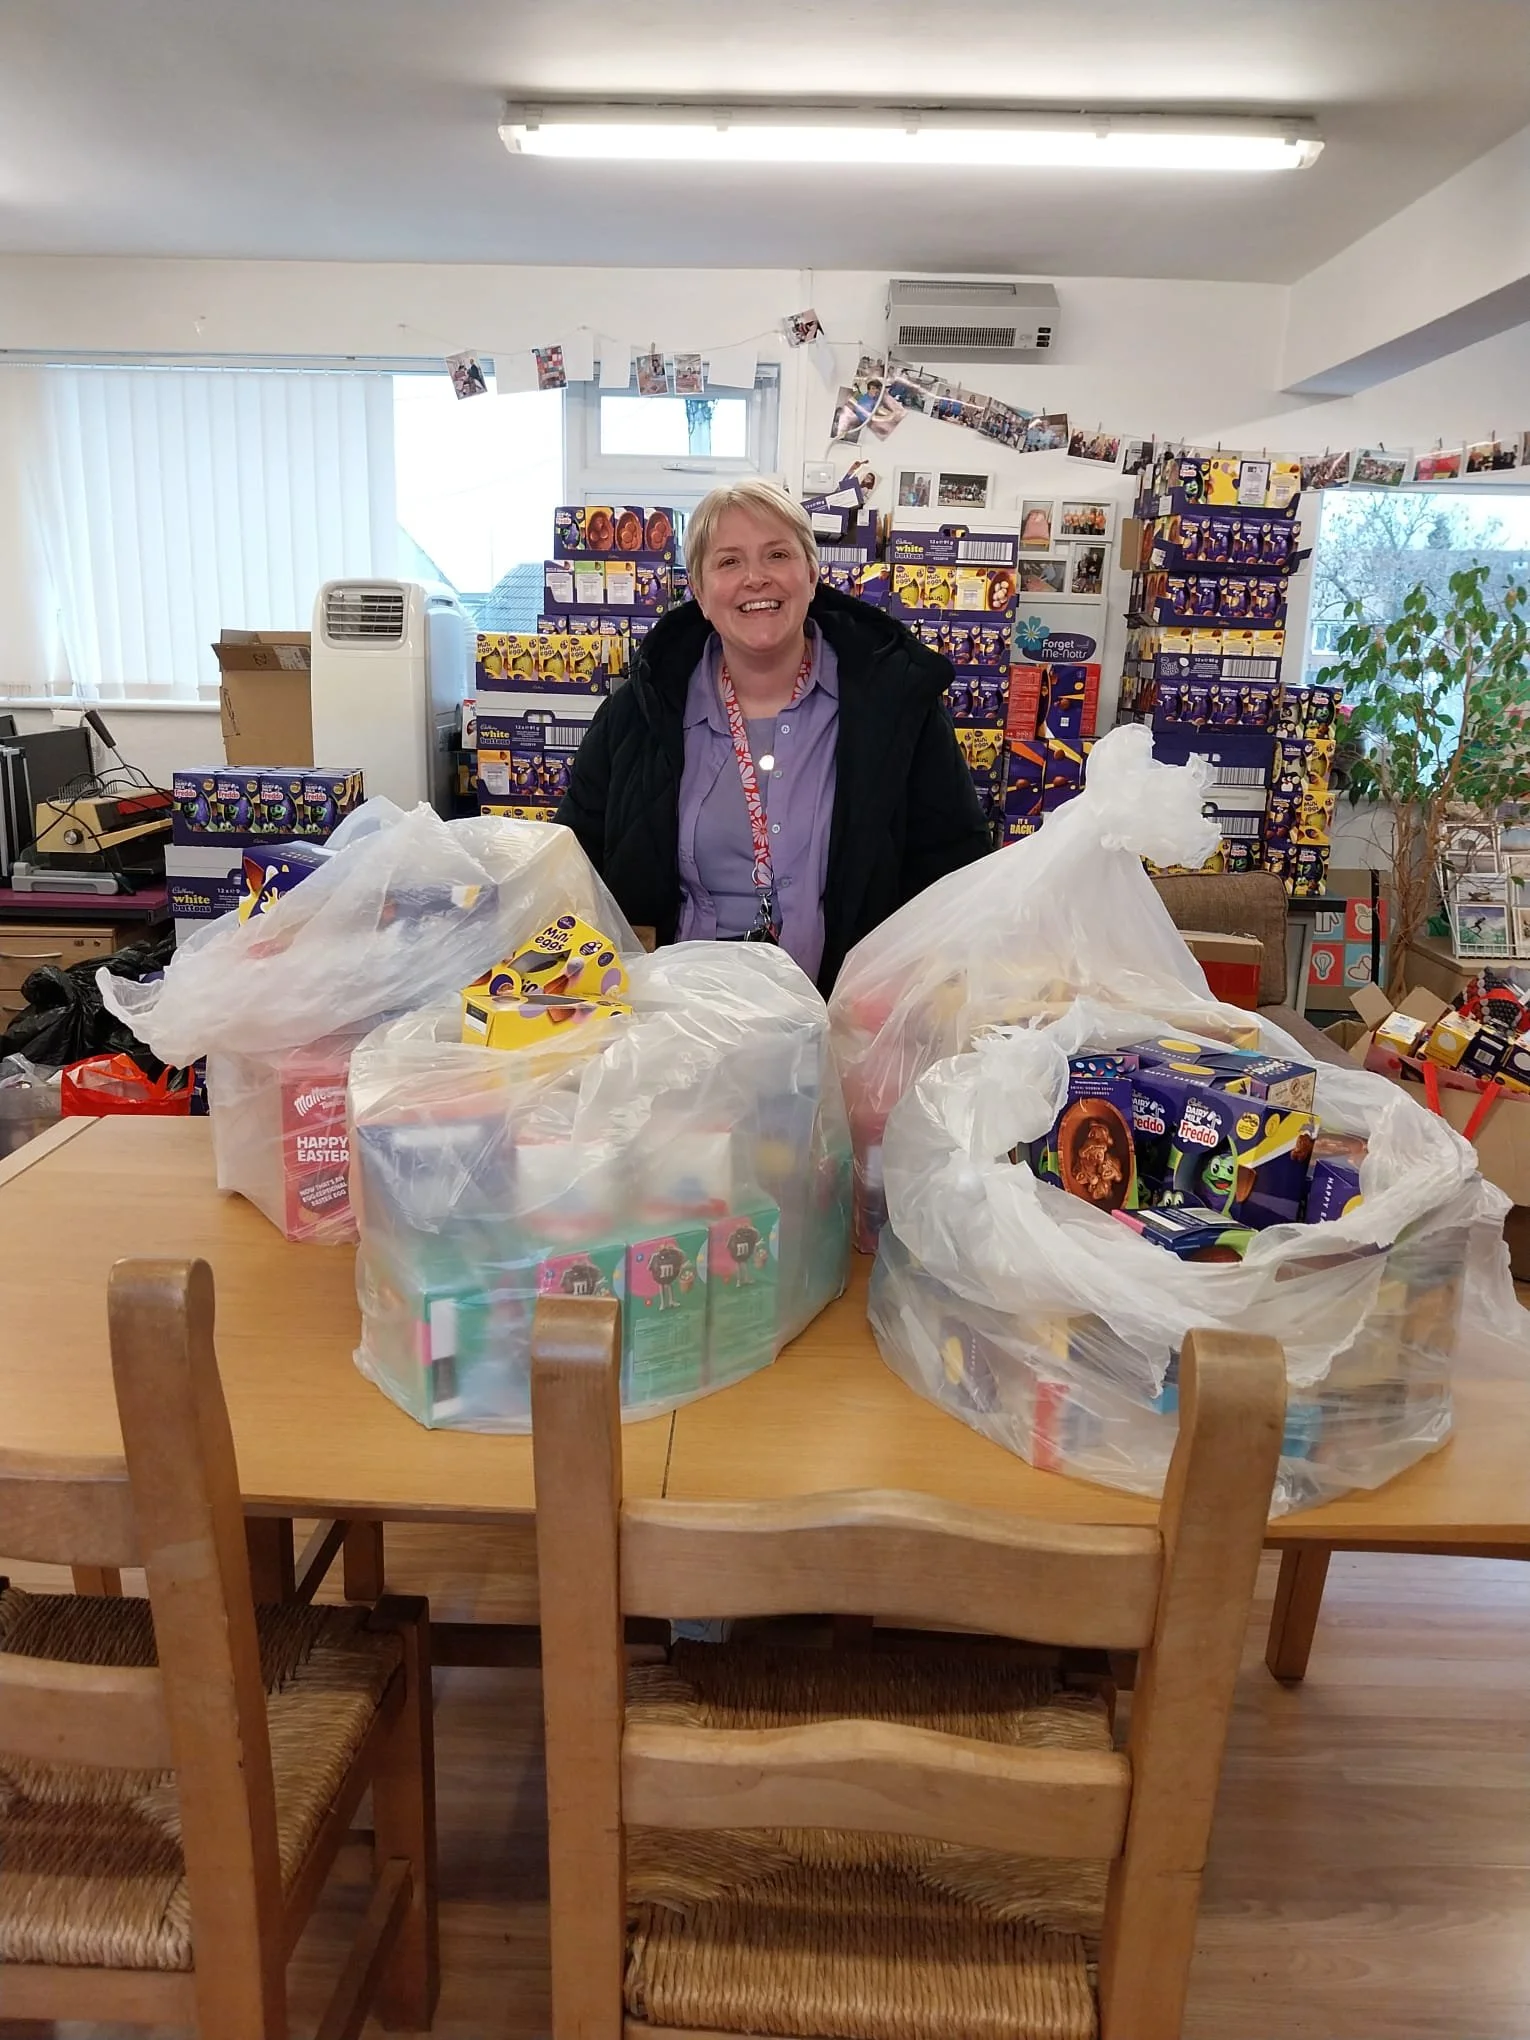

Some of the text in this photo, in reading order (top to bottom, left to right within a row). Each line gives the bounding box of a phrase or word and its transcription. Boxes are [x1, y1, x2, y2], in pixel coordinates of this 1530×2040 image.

[896, 545, 924, 553] white
[1042, 640, 1075, 650] Forget
[1042, 649, 1087, 659] Me-Notts
[480, 730, 510, 739] white
[173, 894, 210, 904] white
[172, 903, 211, 913] buttons
[543, 927, 573, 943] Mini
[535, 936, 564, 951] eggs
[1132, 1098, 1150, 1107] AIRY
[1185, 1105, 1210, 1118] DAIRY
[1184, 1113, 1202, 1125] MILK
[1180, 1122, 1217, 1146] Freddo
[297, 1136, 349, 1149] HAPPY
[297, 1150, 350, 1162] EASTER
[1322, 1176, 1335, 1209] HAPPY
[660, 1263, 675, 1278] m
[573, 1280, 588, 1295] m
